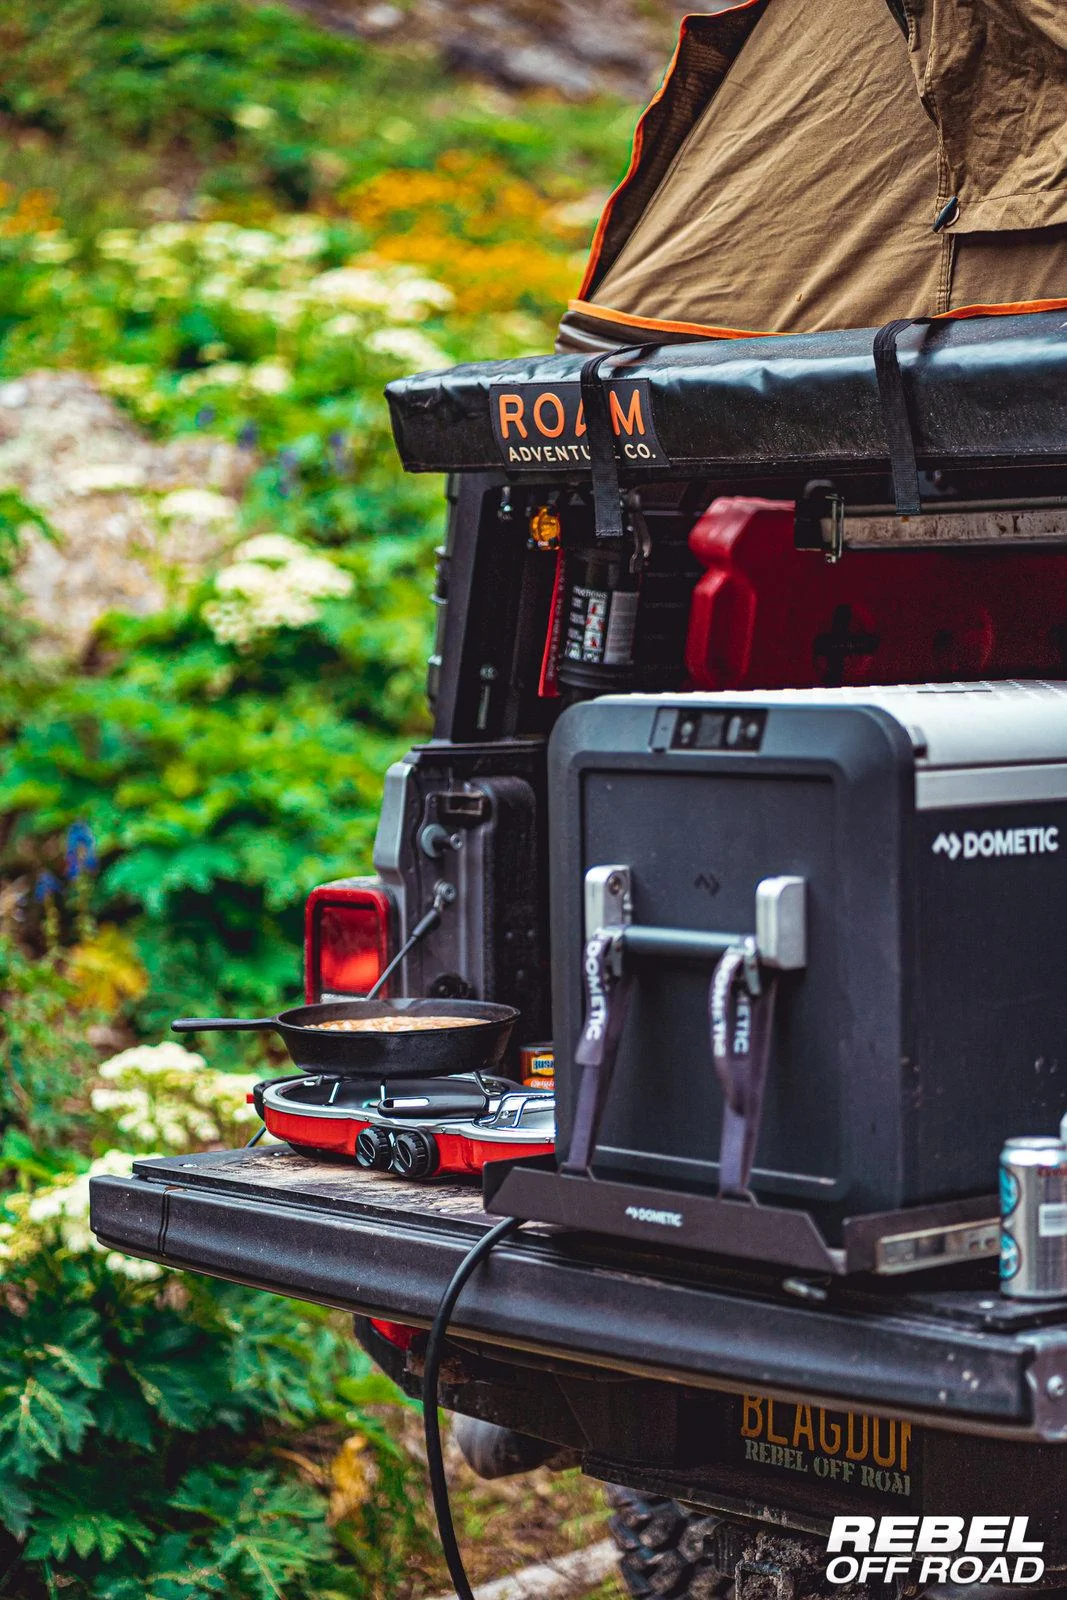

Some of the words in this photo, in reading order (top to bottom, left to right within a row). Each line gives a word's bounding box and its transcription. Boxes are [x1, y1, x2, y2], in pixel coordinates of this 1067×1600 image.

[624, 443, 656, 459] CO.
[963, 827, 1059, 858] DOMETIC
[585, 941, 607, 1041] DOMETIC
[745, 1439, 808, 1473] REBEL
[813, 1456, 855, 1483] OFF
